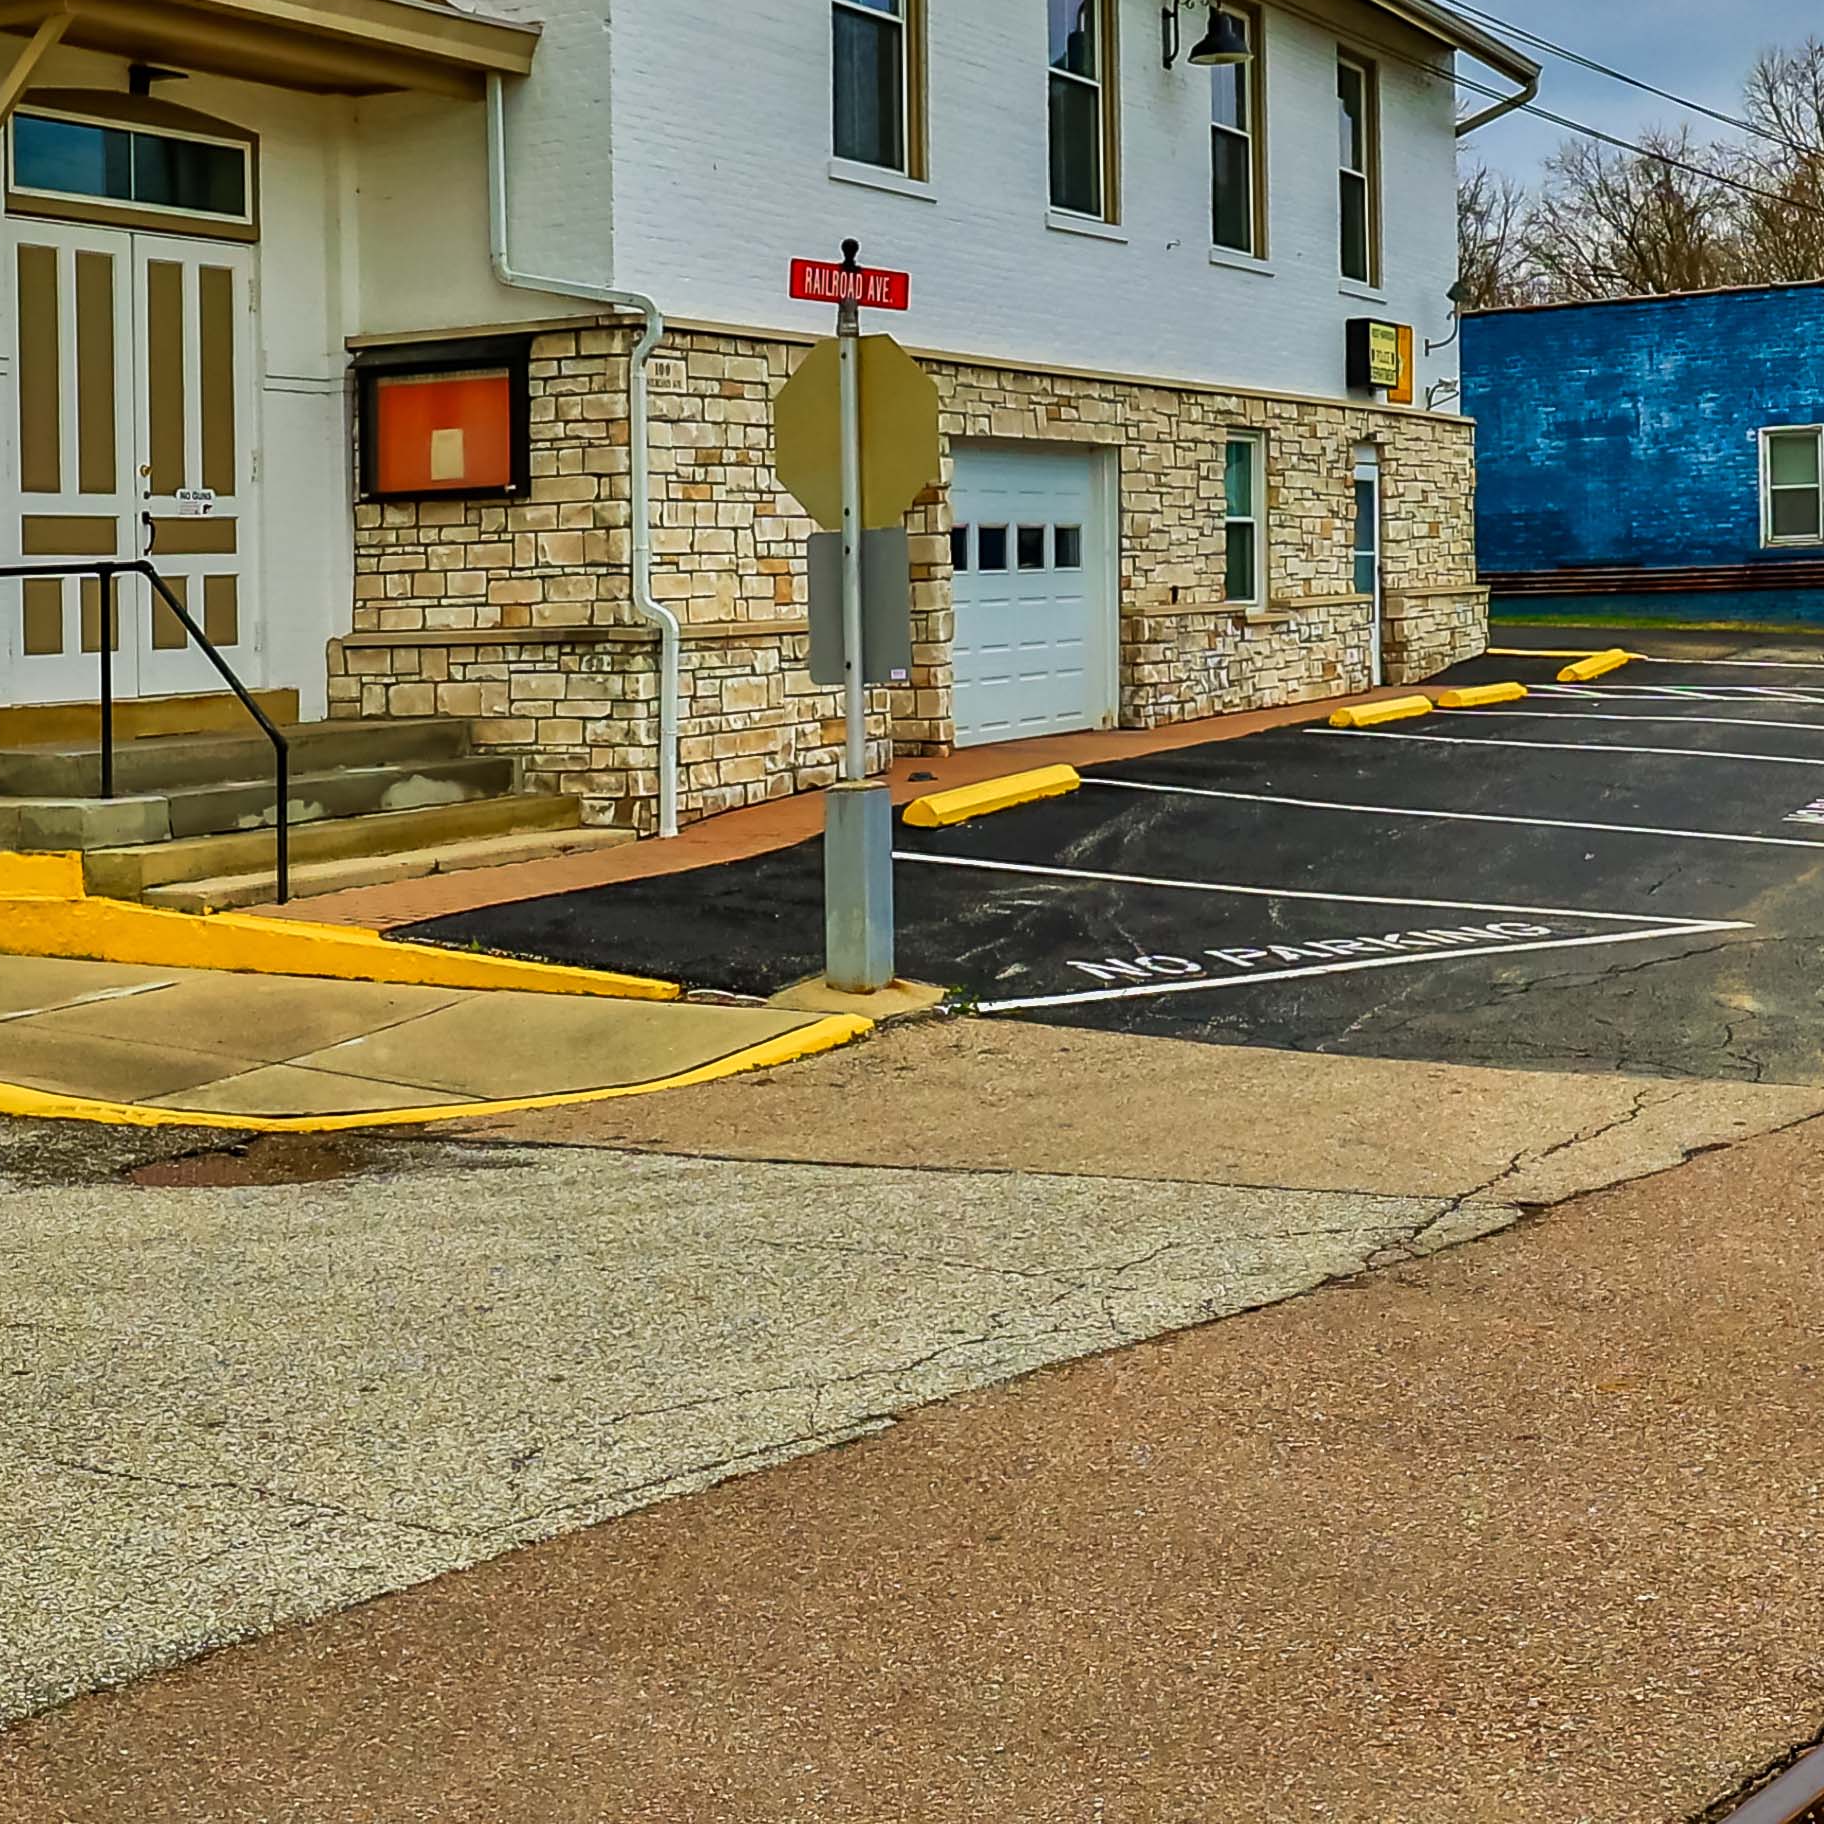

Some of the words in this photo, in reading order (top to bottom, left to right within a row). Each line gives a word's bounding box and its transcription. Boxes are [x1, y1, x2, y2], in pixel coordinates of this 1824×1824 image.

[805, 266, 863, 300] RAILROAD
[867, 275, 894, 304] AVE.
[1065, 954, 1204, 981] NO
[1203, 921, 1553, 968] PARKING
